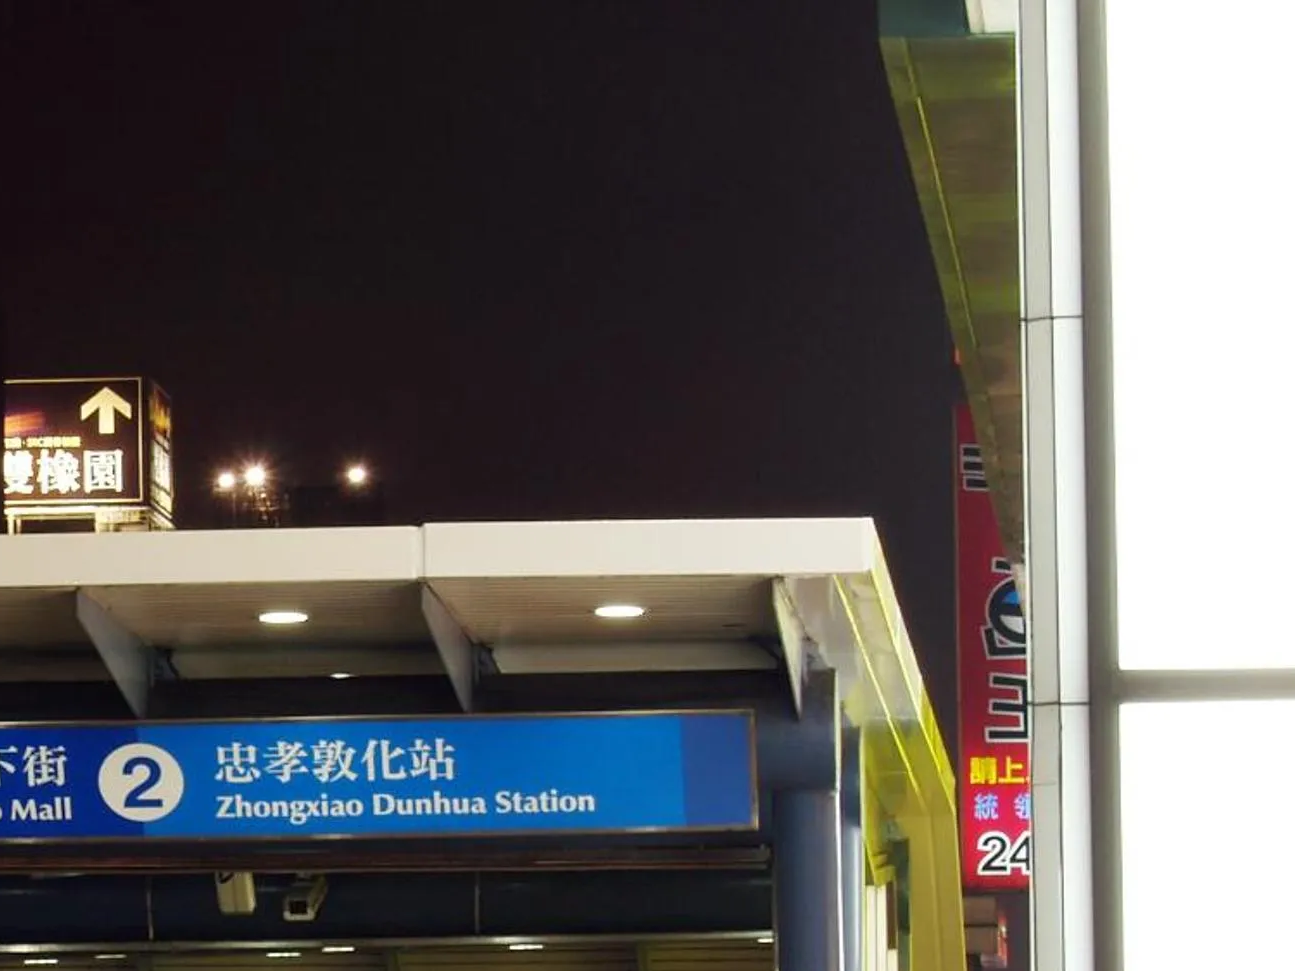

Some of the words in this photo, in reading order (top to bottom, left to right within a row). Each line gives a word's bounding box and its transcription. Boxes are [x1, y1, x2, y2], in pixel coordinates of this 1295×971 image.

[122, 756, 163, 808] 2
[214, 738, 456, 785] 忠孝敦化站
[11, 797, 73, 821] Mall
[215, 793, 364, 825] Zhongxiao
[373, 790, 487, 816] Dunhua
[495, 789, 596, 814] Station
